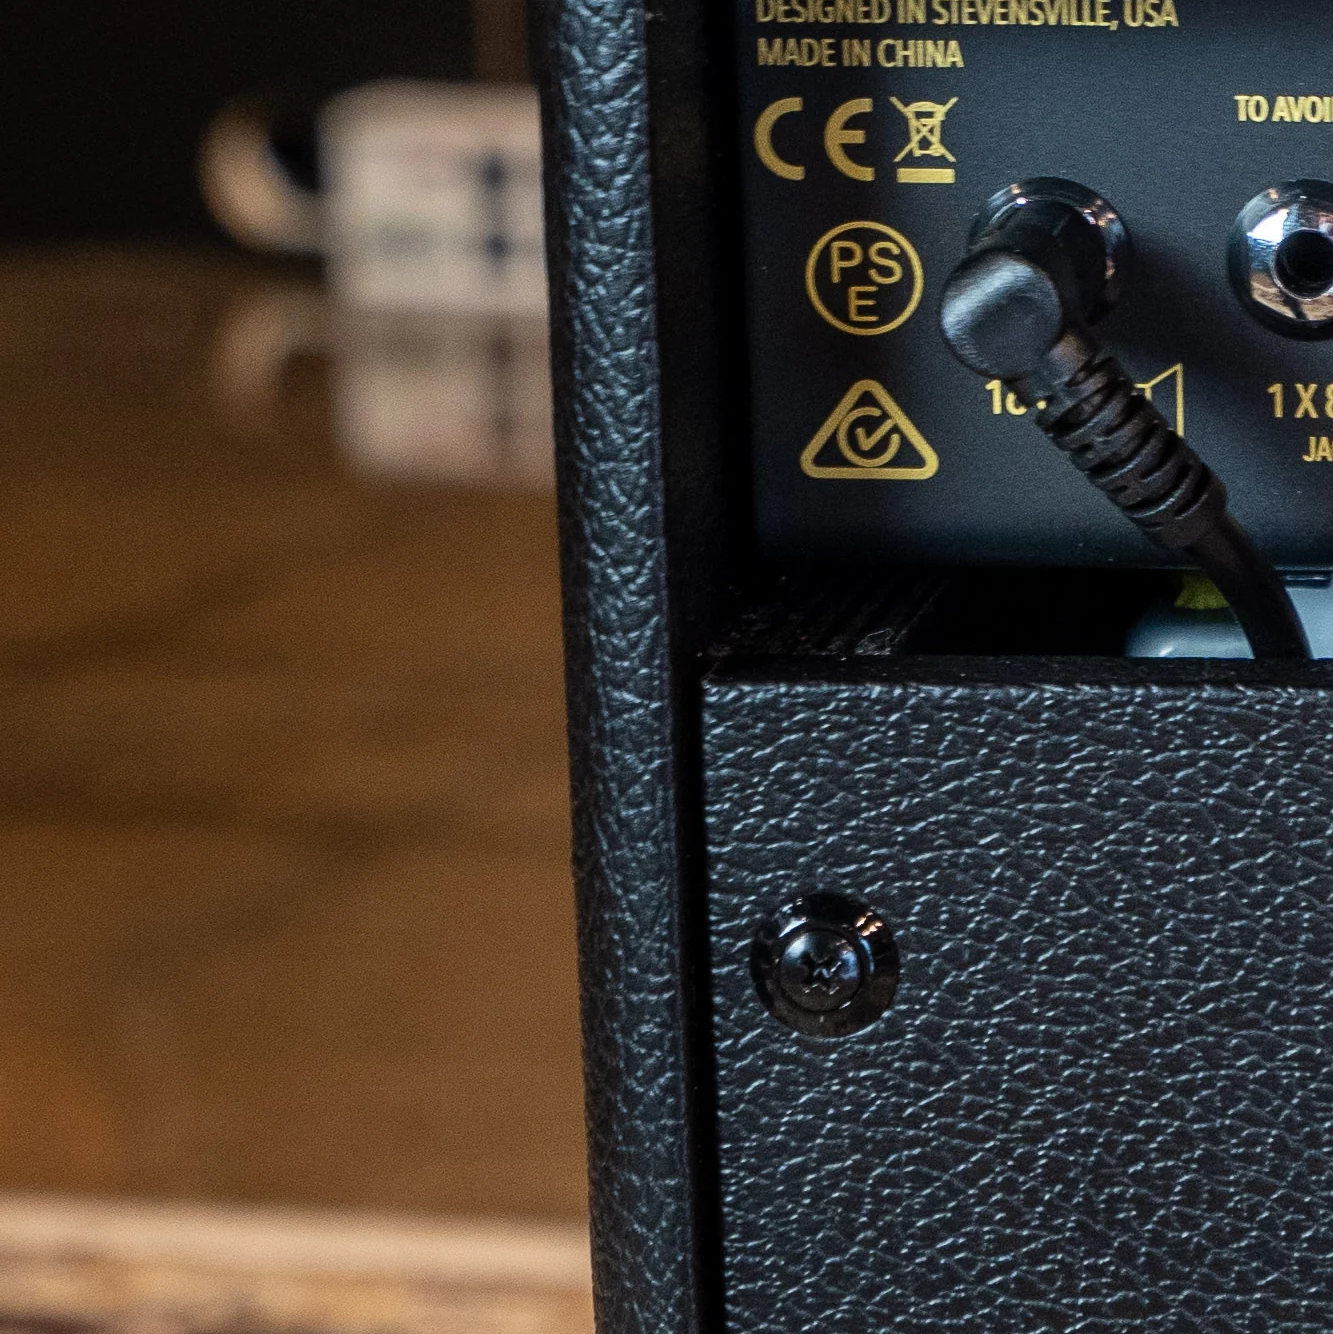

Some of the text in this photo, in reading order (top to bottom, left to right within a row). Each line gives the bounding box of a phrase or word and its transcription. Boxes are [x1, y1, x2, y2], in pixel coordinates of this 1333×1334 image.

[756, 36, 964, 68] MADE IN CHINA
[1234, 93, 1270, 123] TO
